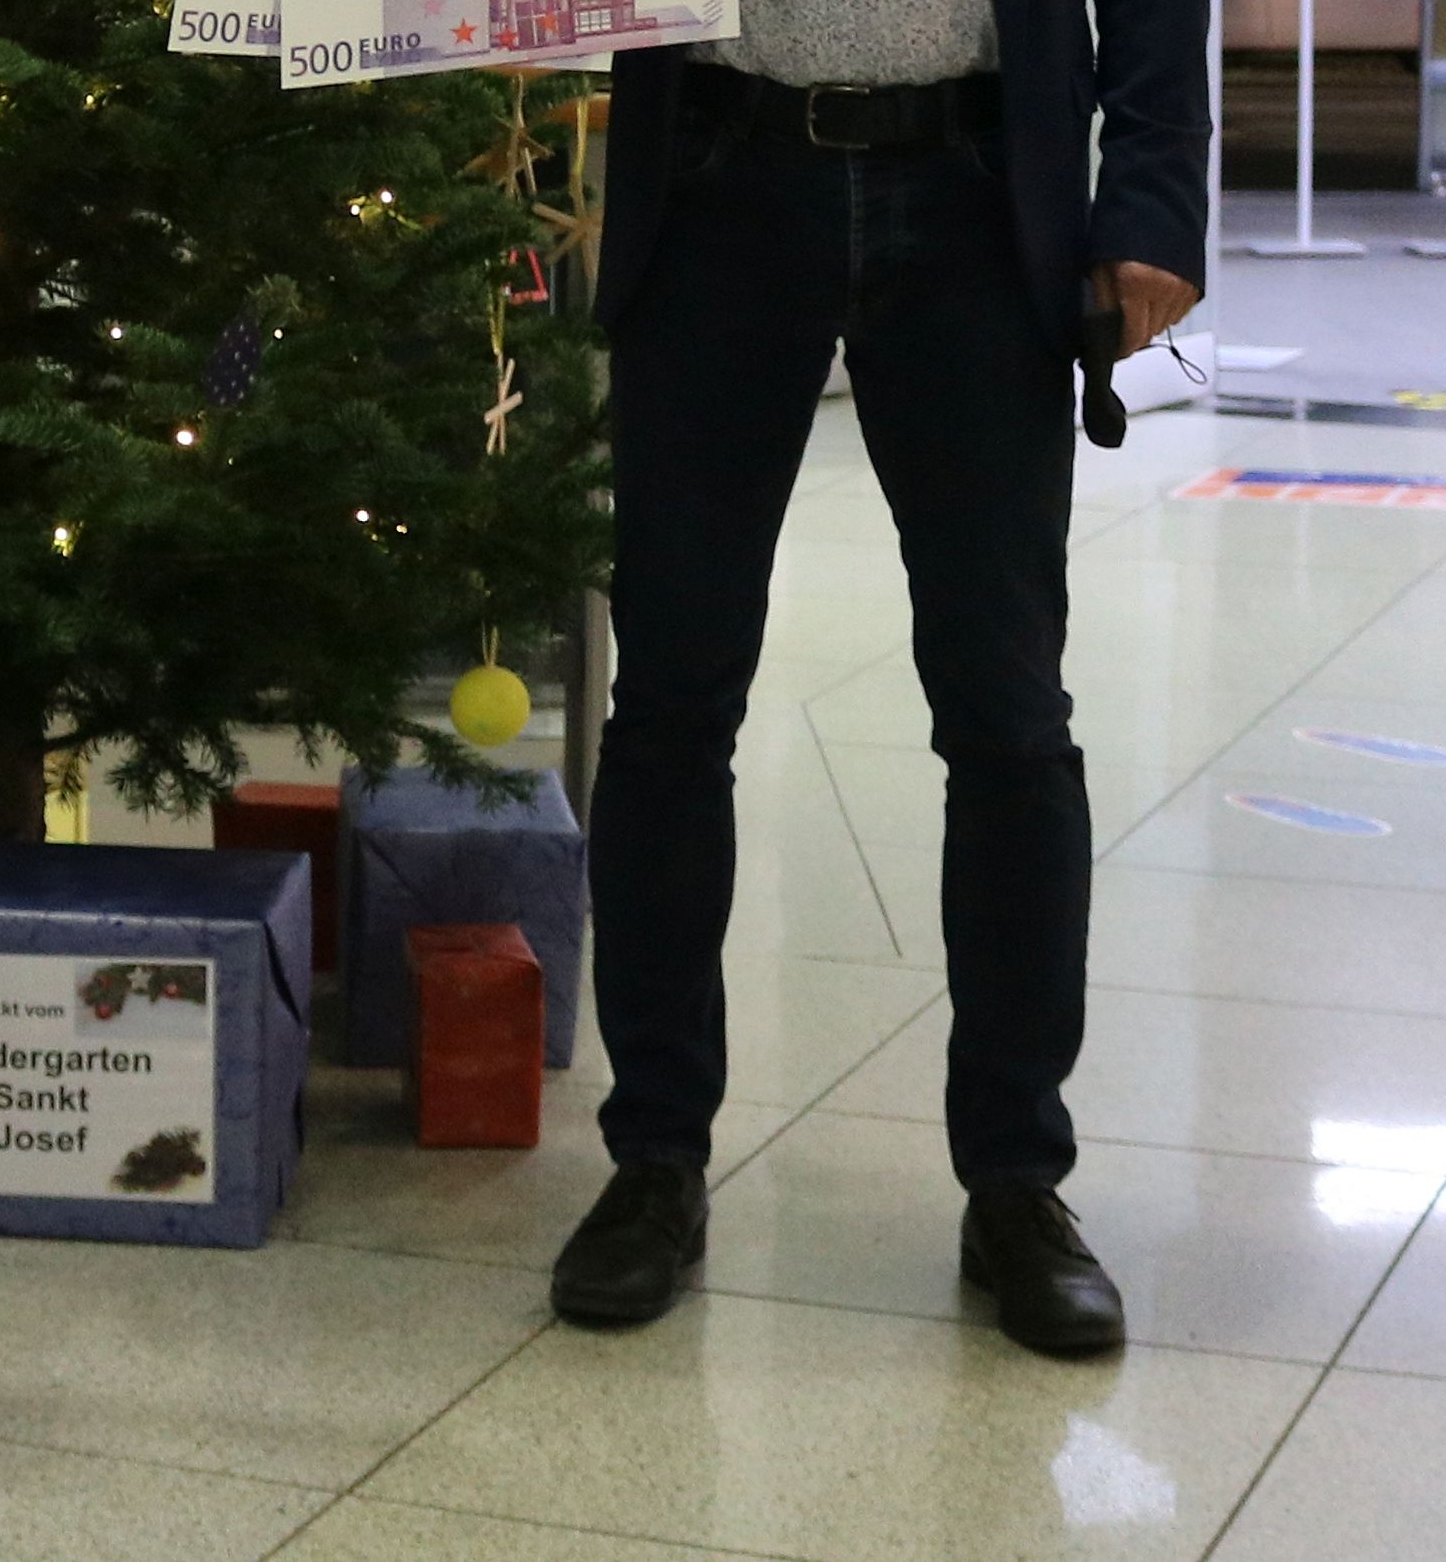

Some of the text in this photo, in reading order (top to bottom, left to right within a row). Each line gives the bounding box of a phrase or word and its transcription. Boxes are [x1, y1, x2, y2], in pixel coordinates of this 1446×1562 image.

[178, 10, 281, 43] 500 EU
[289, 32, 421, 78] 500 EURO
[25, 1003, 64, 1017] vom
